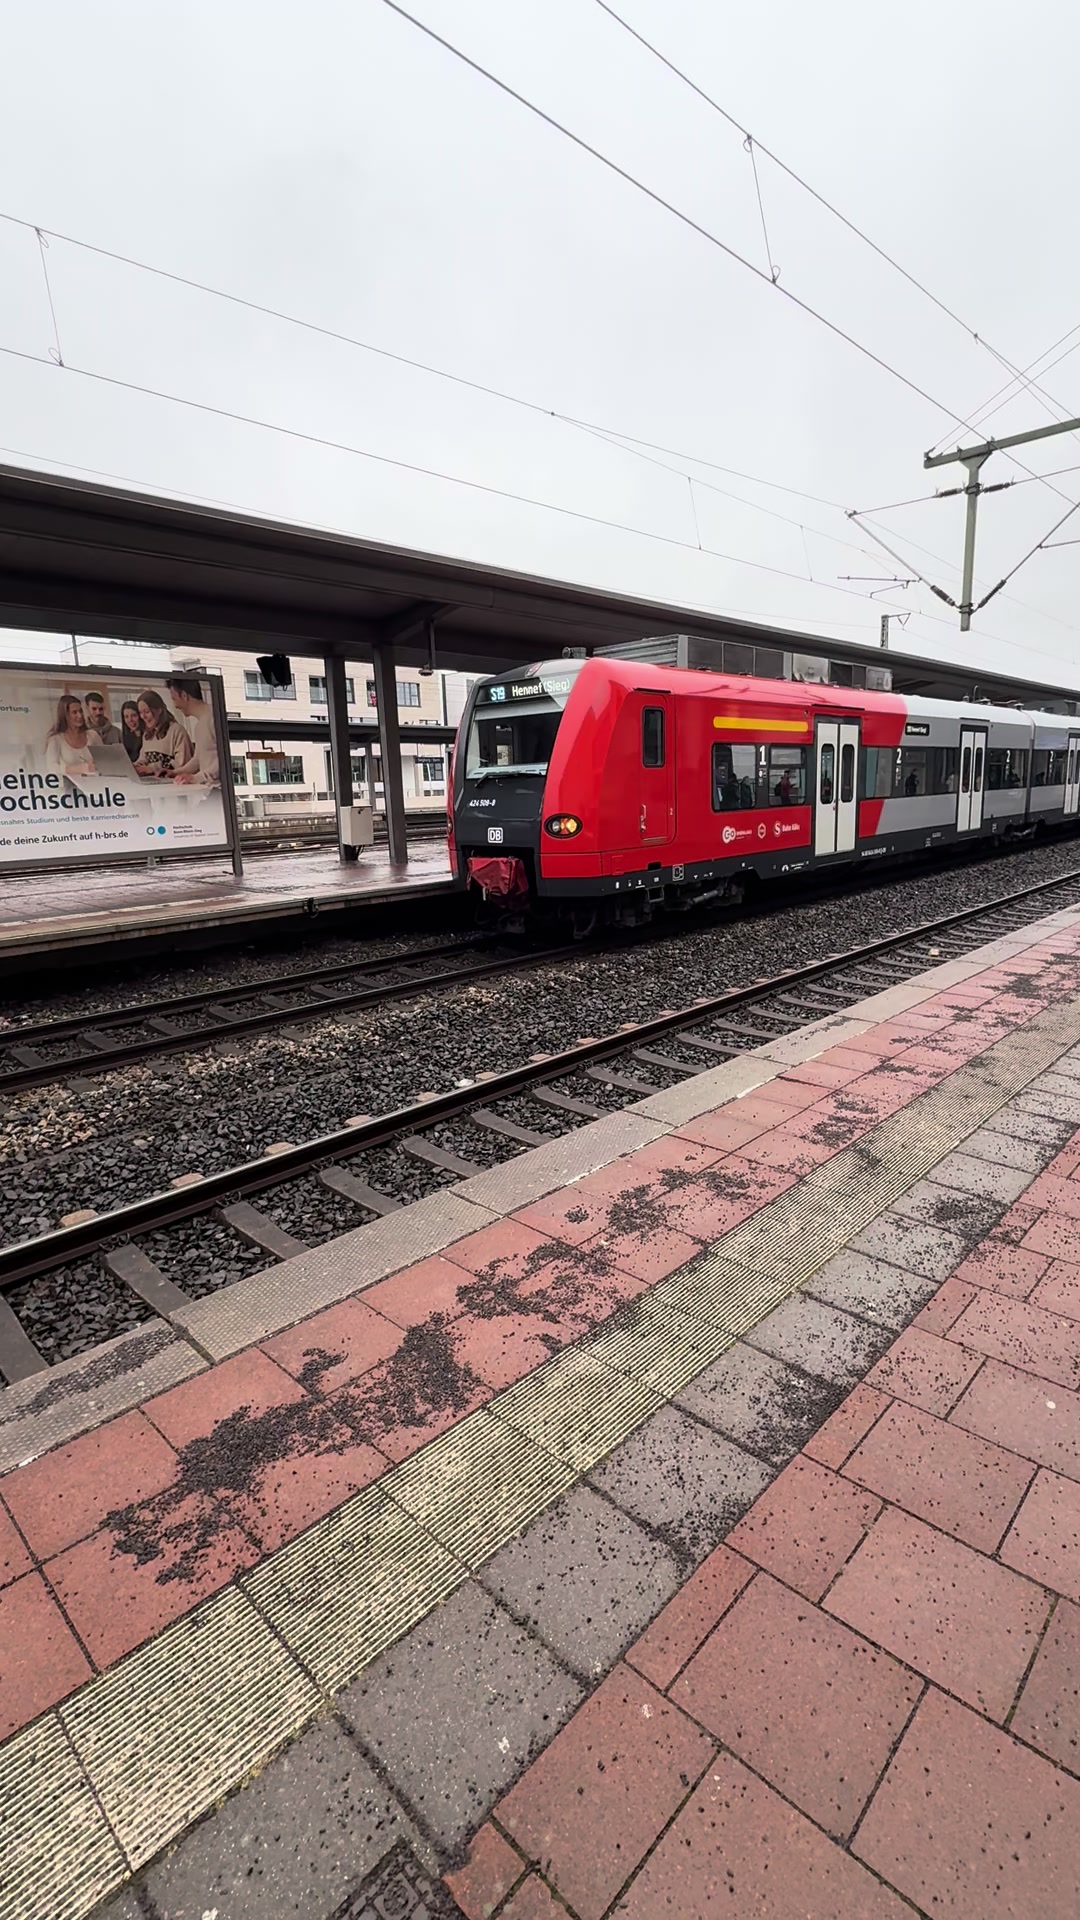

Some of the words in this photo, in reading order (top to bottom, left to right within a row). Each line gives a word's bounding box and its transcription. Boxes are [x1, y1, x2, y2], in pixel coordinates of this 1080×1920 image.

[490, 686, 505, 701] S19
[511, 682, 542, 697] Hennef
[759, 745, 767, 765] 1
[896, 748, 902, 764] 2
[0, 769, 59, 790] eine
[0, 787, 126, 811] ochschule
[26, 817, 55, 825] Studium
[91, 813, 140, 821] Karrierechancen
[14, 836, 40, 845] deine
[41, 833, 78, 844] Zukunft
[79, 831, 93, 841] auf
[95, 830, 129, 840] h-brs.de
[489, 829, 502, 842] DB
